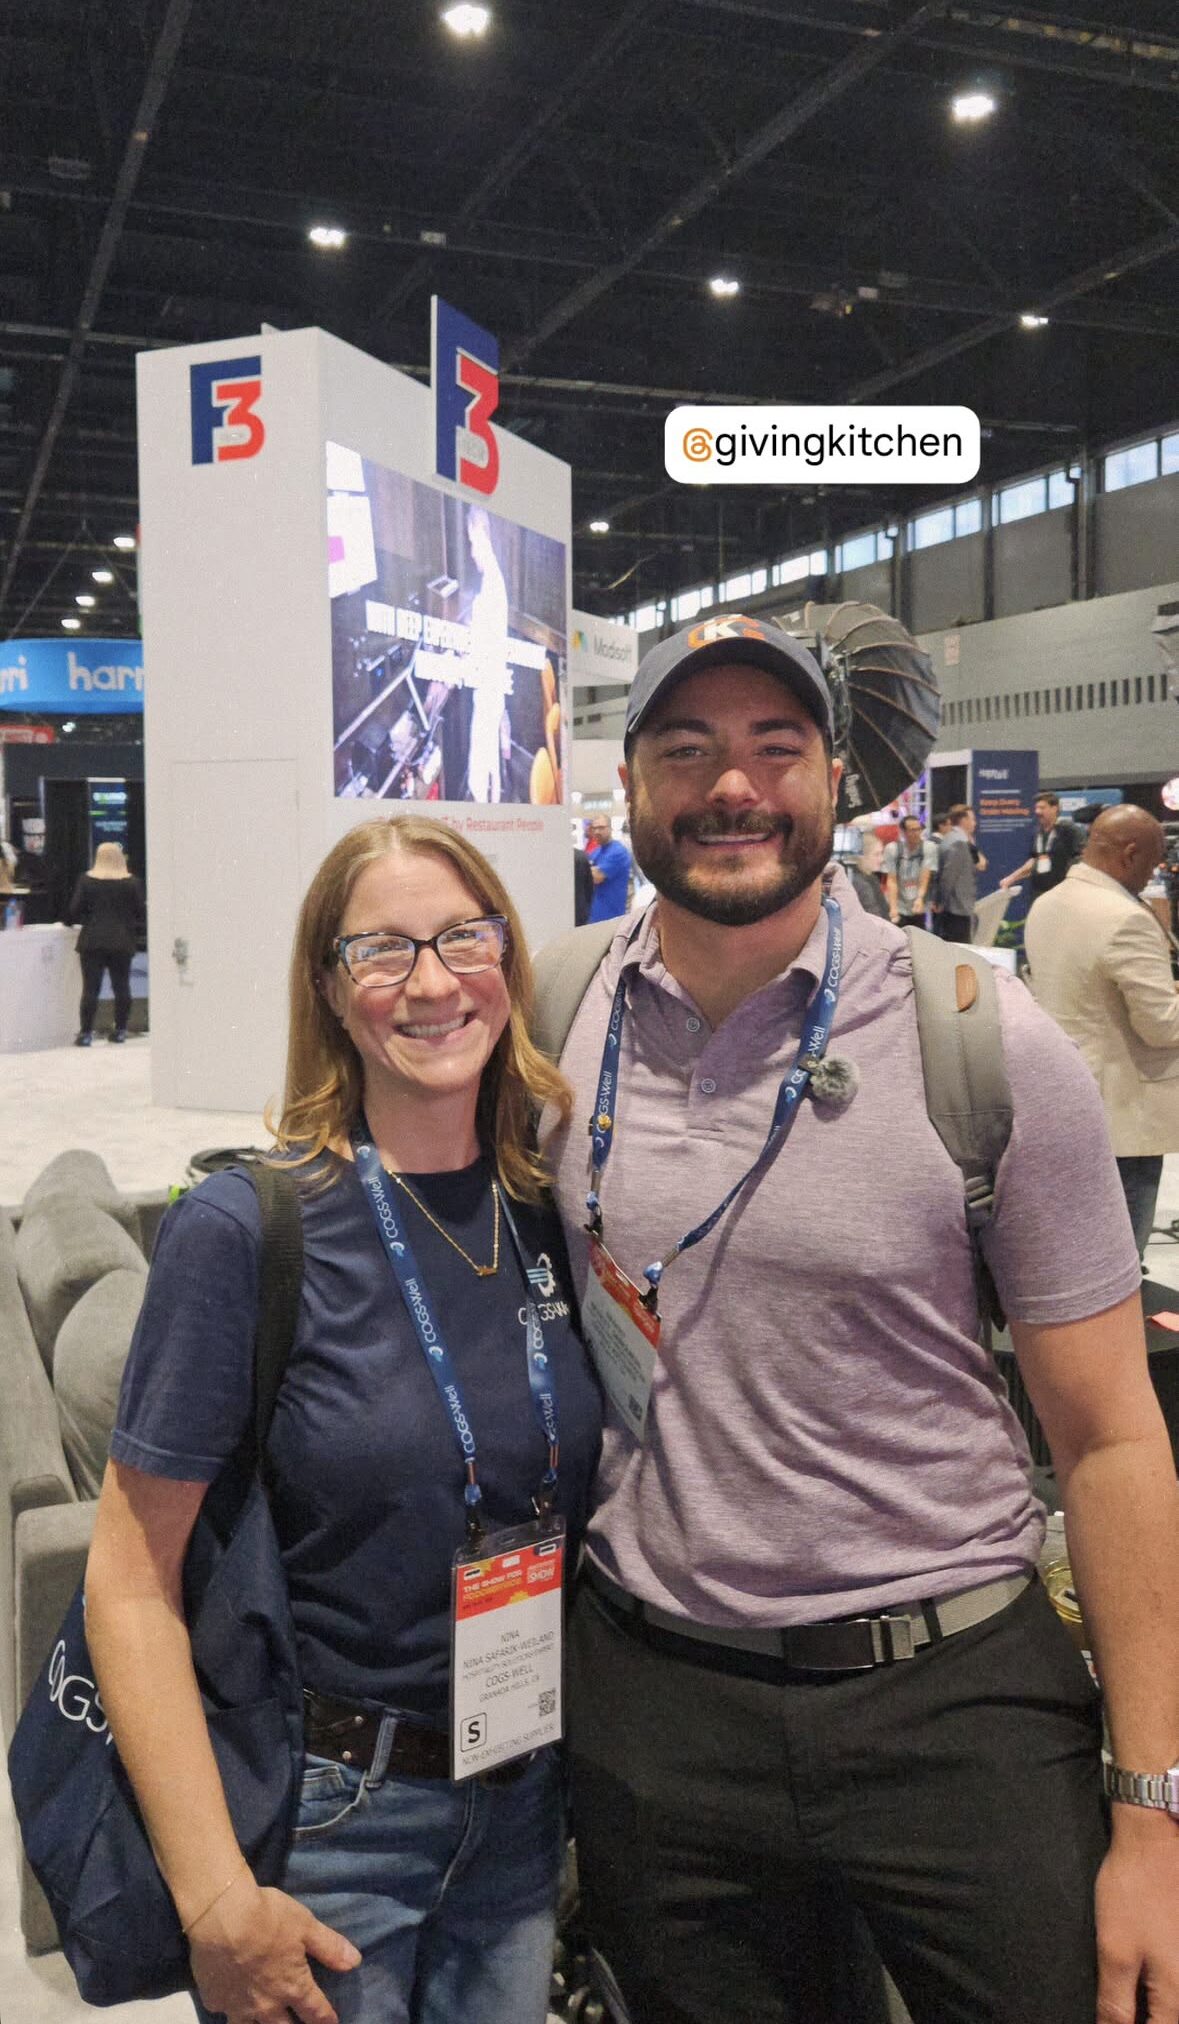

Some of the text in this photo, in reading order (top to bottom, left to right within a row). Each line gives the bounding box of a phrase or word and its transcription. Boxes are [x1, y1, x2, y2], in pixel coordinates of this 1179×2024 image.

[190, 355, 266, 465] F3
[436, 296, 500, 496] F3
[466, 816, 514, 832] Restaurant
[516, 817, 545, 832] People
[467, 1720, 481, 1744] S
